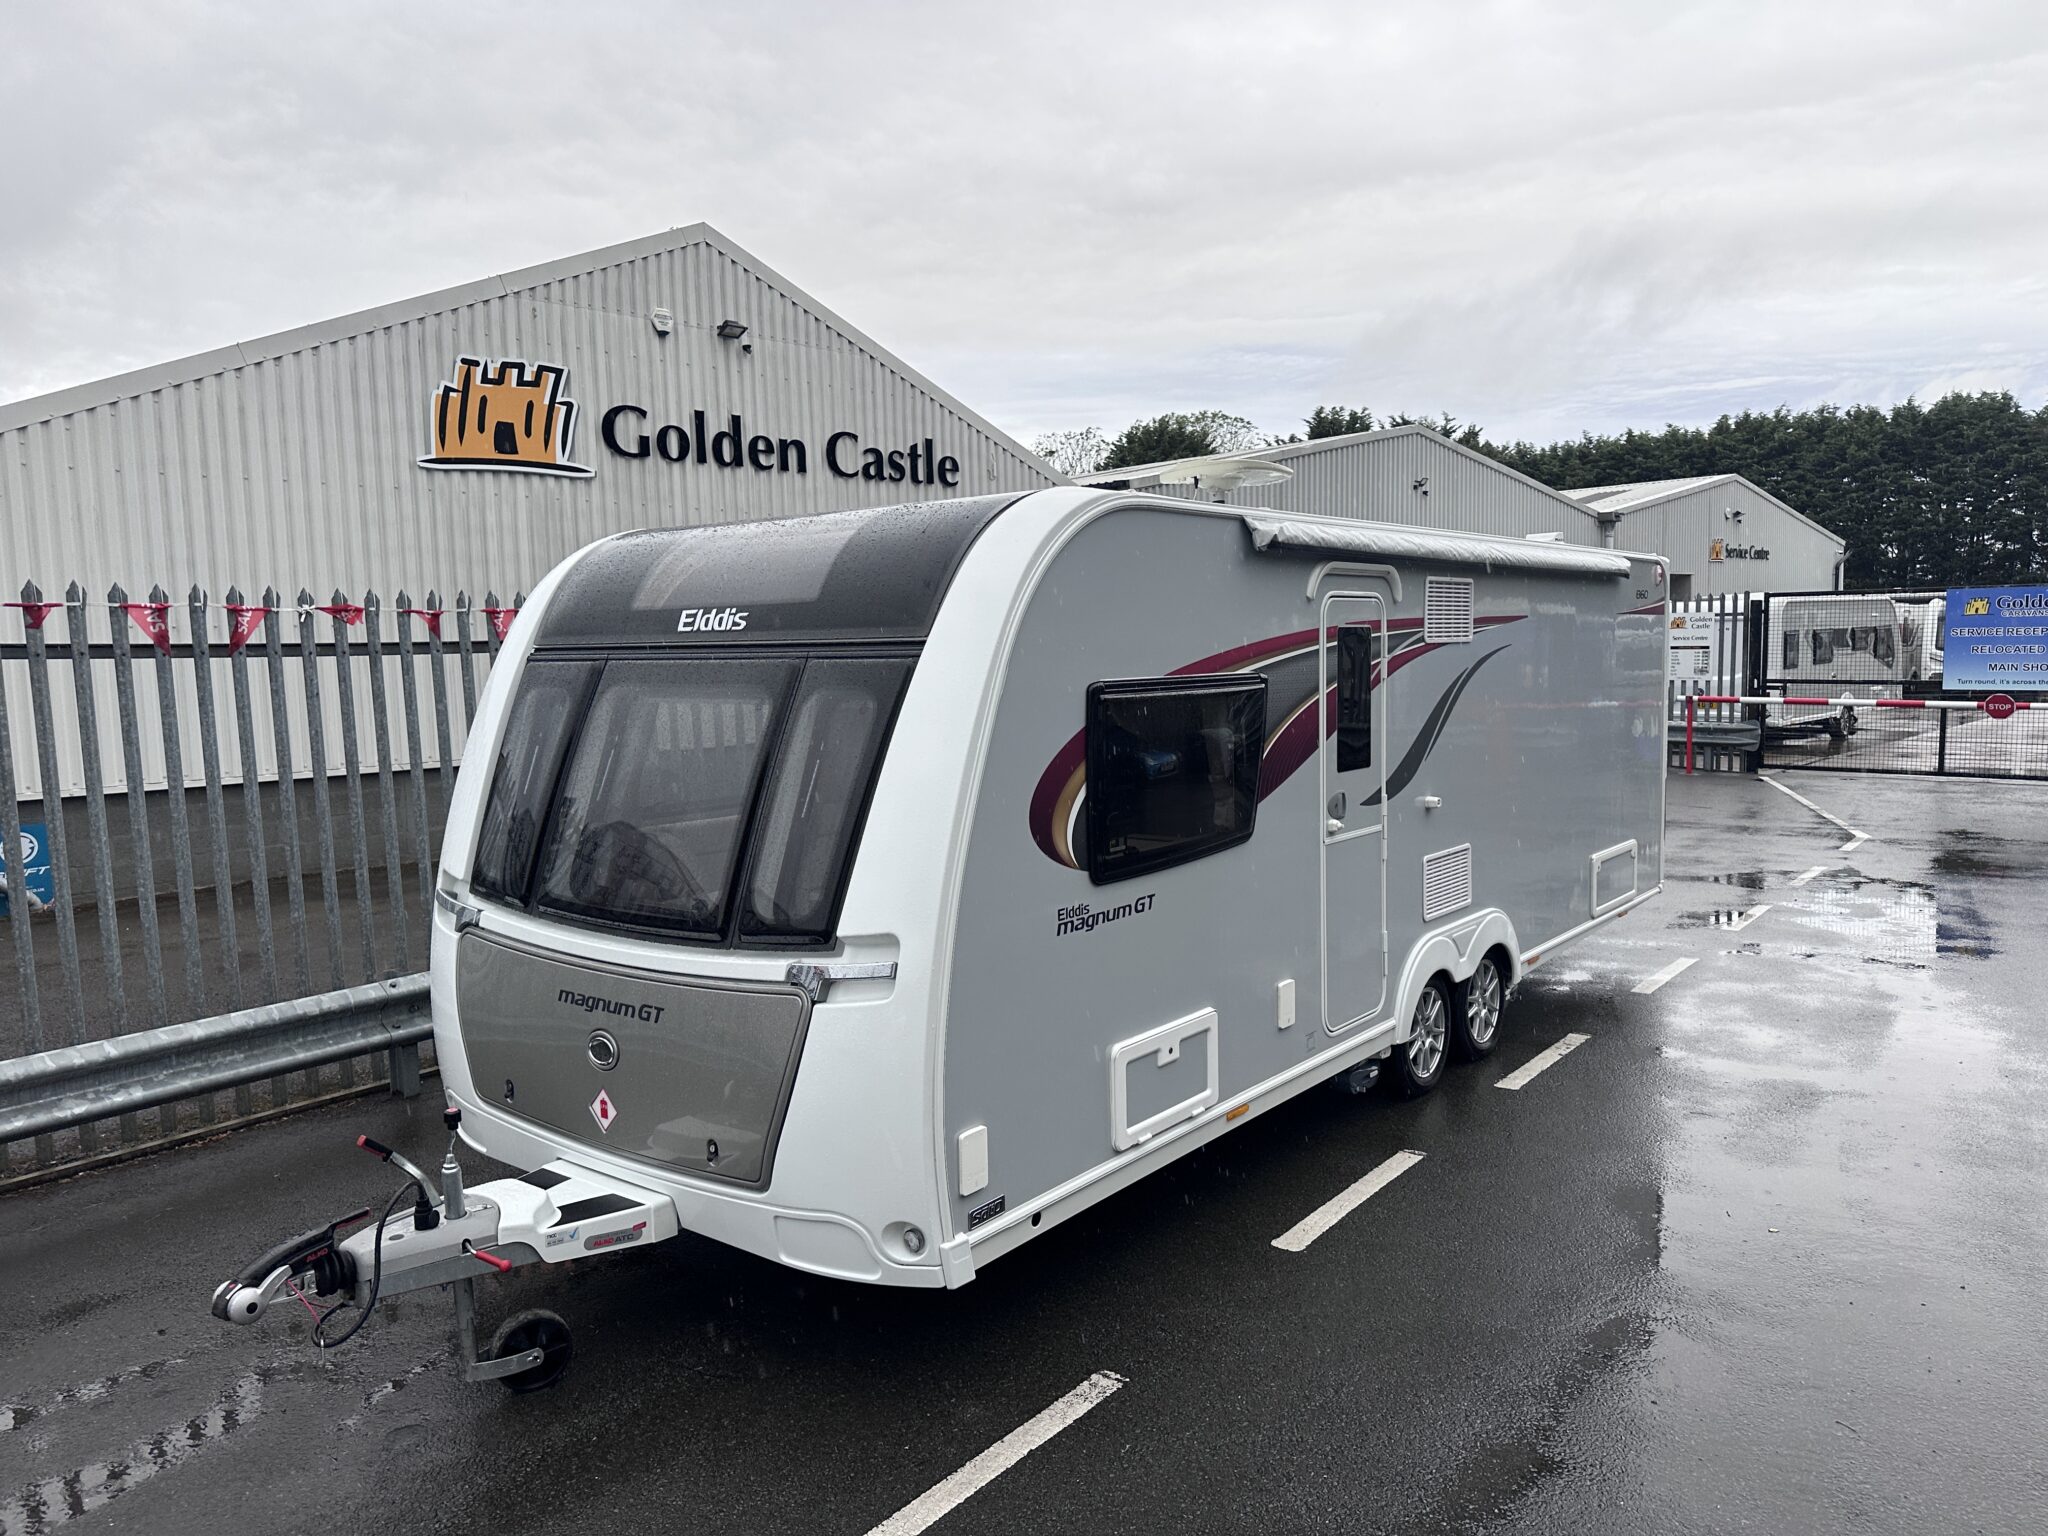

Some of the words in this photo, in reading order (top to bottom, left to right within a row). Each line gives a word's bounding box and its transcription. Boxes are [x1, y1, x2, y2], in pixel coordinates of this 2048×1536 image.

[601, 404, 807, 474] Golden
[826, 431, 960, 488] Castle
[1725, 543, 1748, 559] Service
[1749, 545, 1769, 560] Centre
[677, 607, 749, 632] Elddis
[1951, 627, 2003, 637] SERVICE
[1971, 645, 2046, 654] RELOCATED
[1988, 663, 2019, 672] MAIN
[1056, 904, 1132, 936] magnum
[1134, 893, 1156, 914] GT
[1057, 903, 1090, 922] Elddis
[558, 989, 636, 1018] magnum
[638, 1003, 665, 1024] GT
